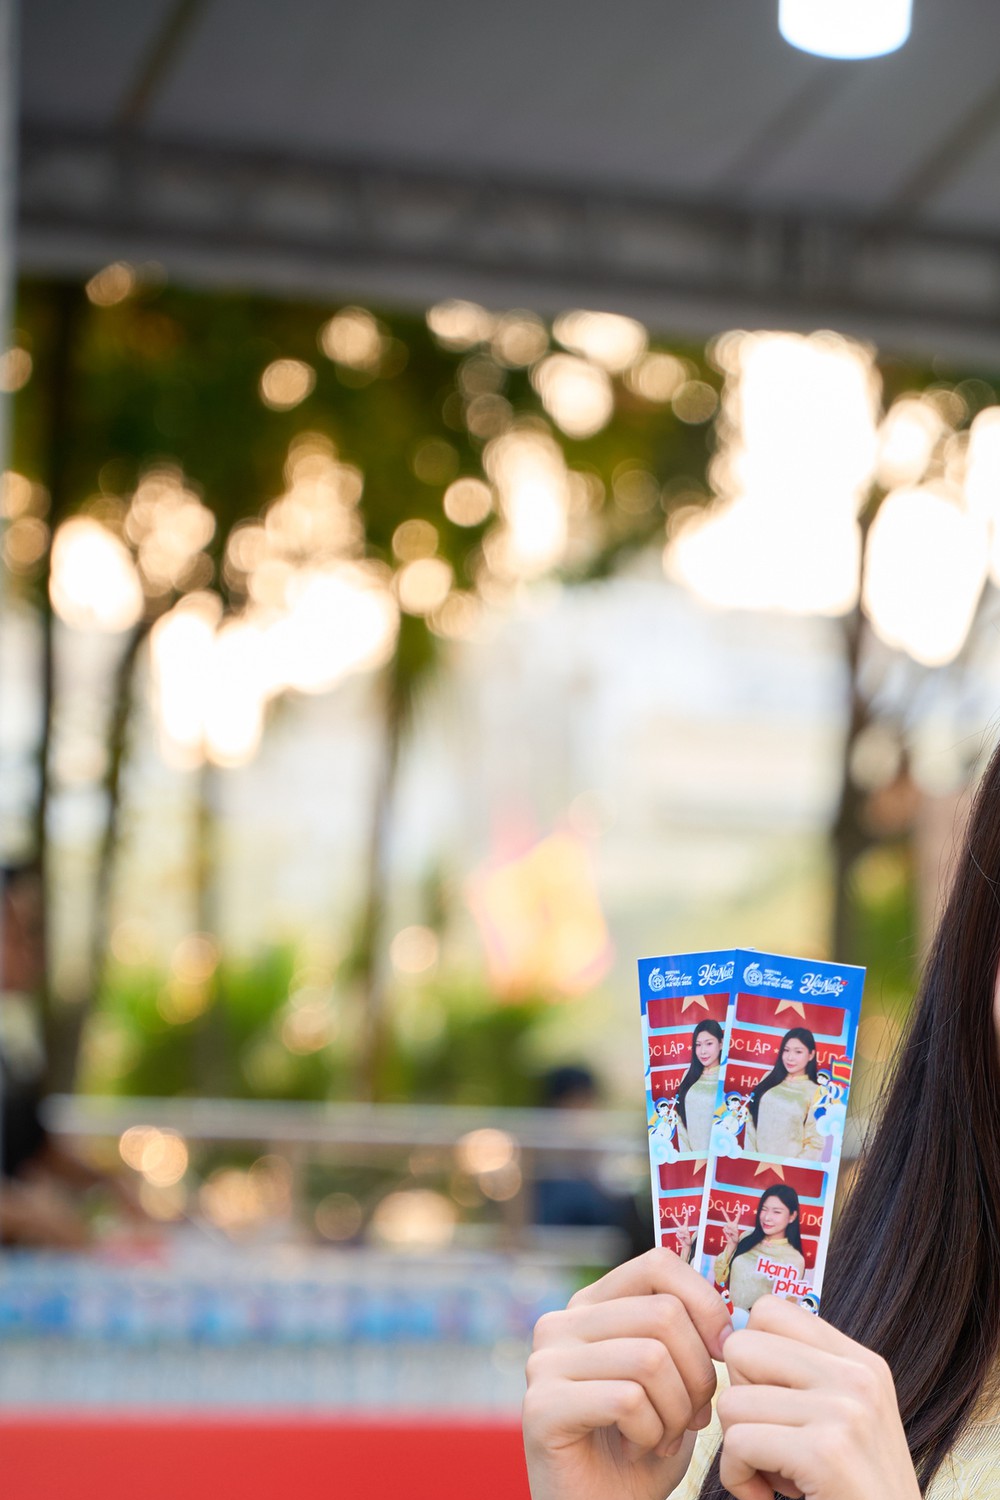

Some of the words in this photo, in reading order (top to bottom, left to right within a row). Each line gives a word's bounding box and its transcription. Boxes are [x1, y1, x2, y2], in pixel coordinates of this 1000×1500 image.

[663, 1040, 685, 1058] LẬP
[746, 1038, 771, 1056] LẬP
[674, 1202, 696, 1220] LẬP
[725, 1199, 751, 1217] LẬP
[757, 1258, 797, 1281] Hạnh
